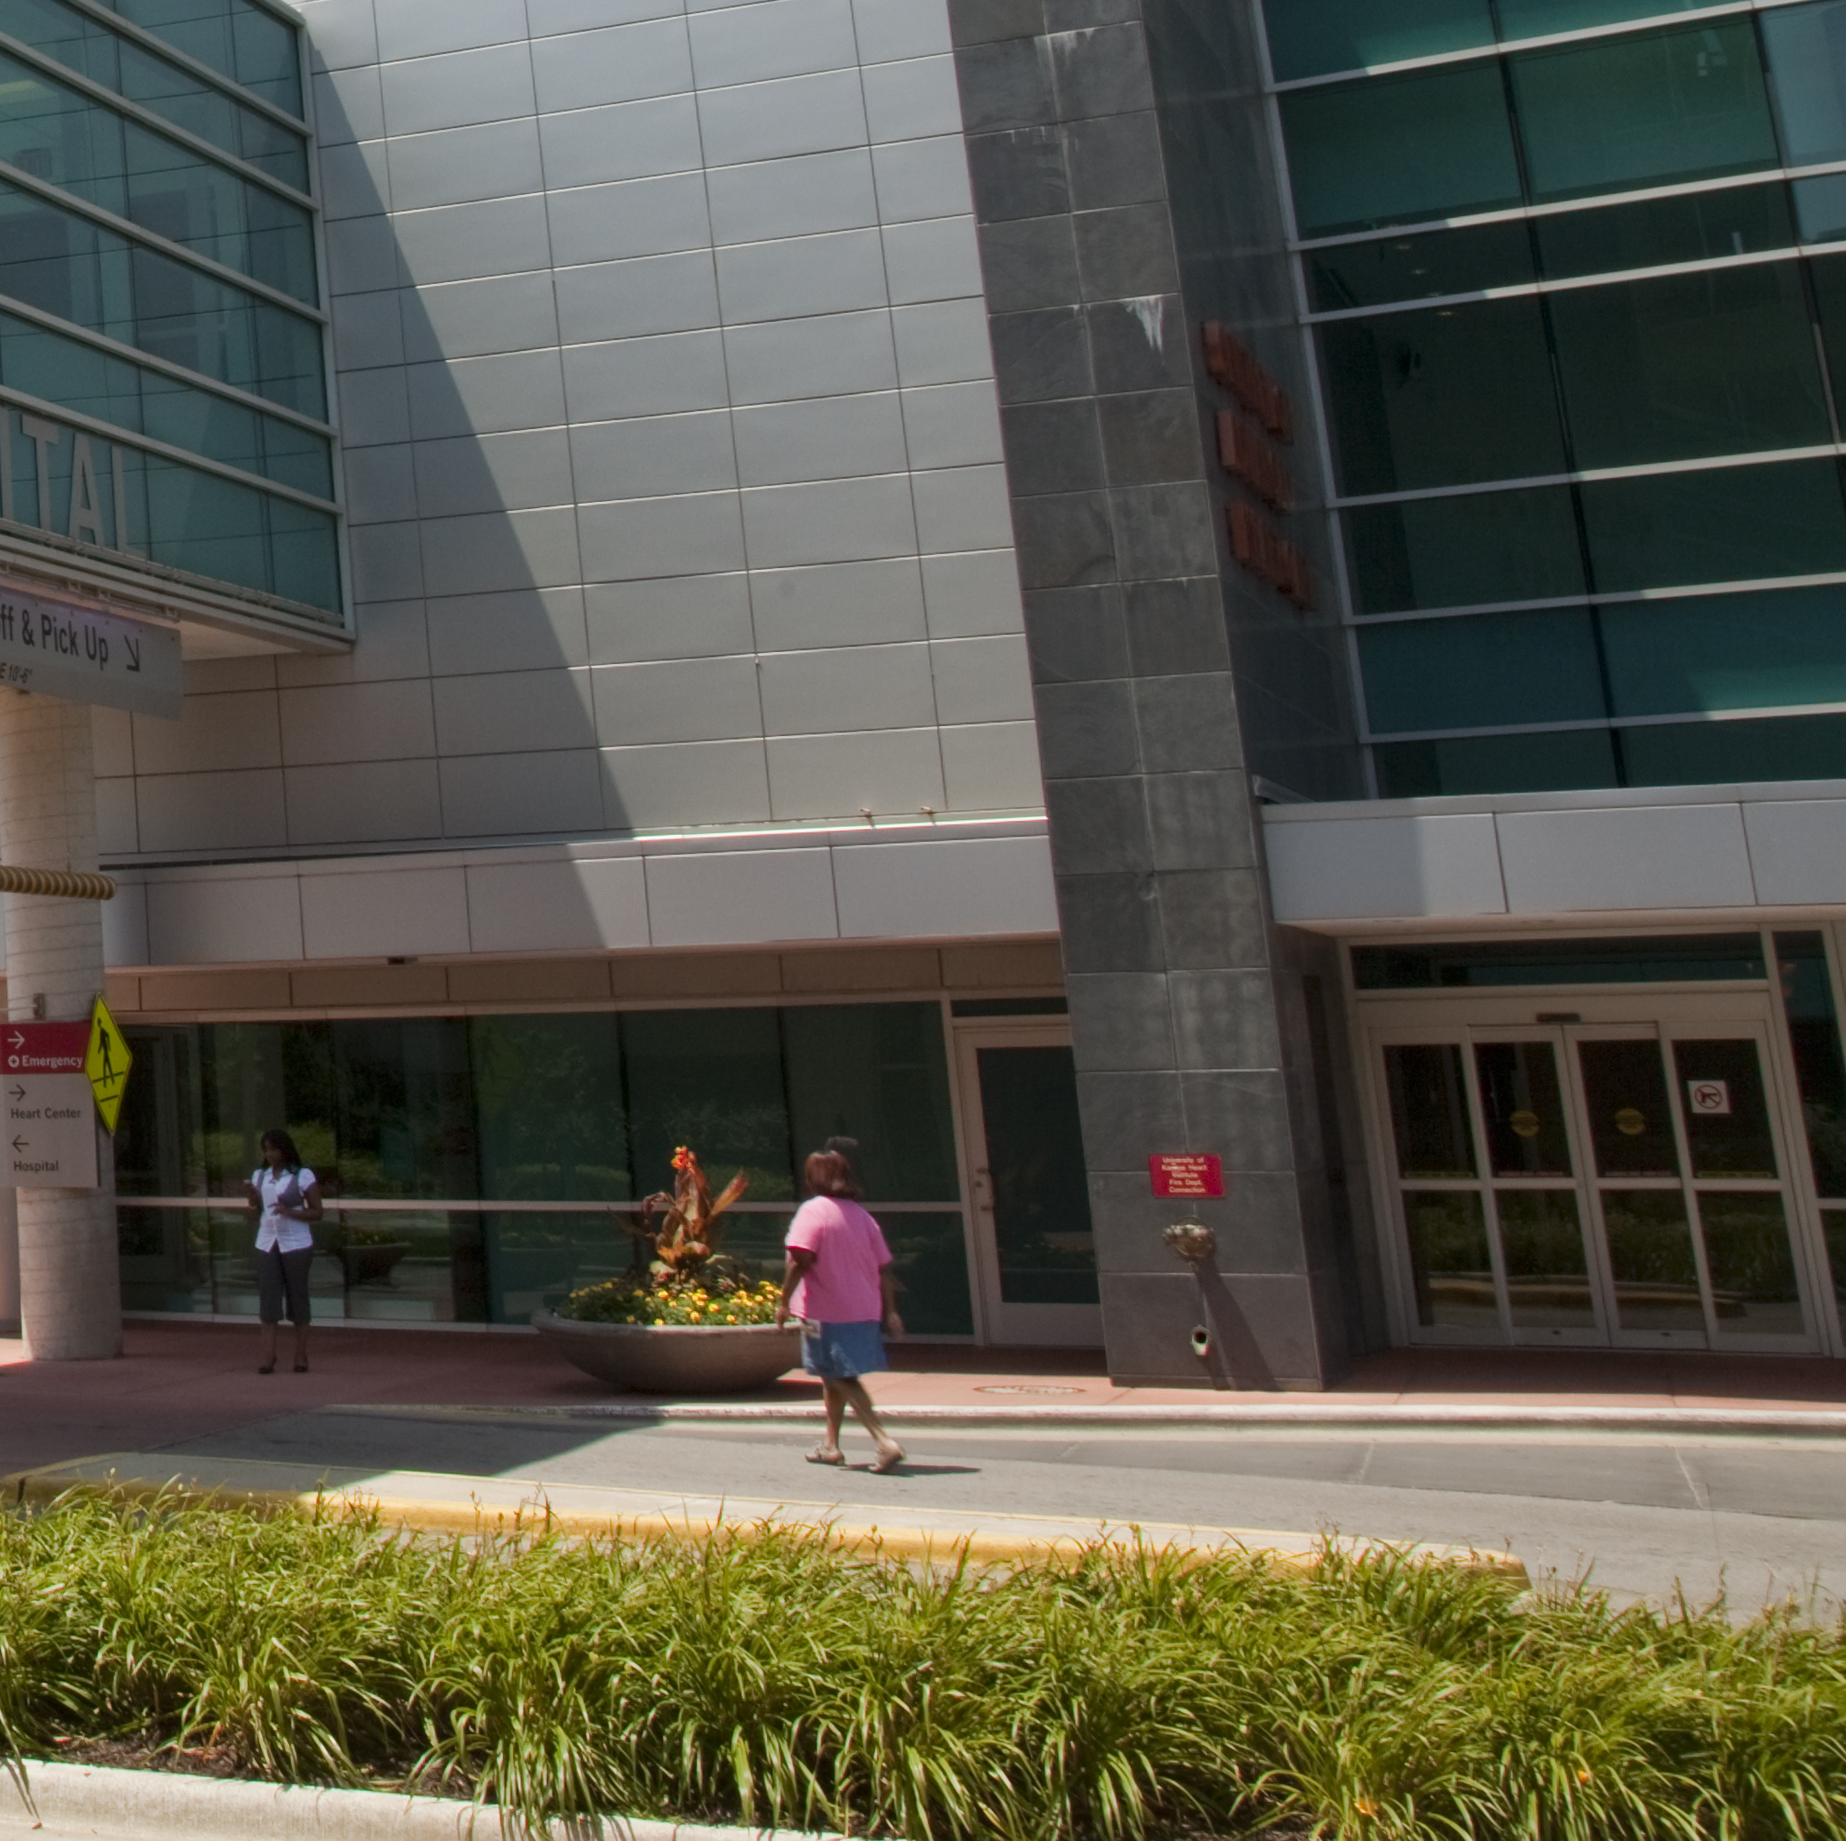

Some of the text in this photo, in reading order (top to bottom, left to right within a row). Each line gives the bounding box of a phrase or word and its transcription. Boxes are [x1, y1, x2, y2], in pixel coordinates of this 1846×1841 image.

[21, 614, 35, 648] &
[41, 614, 79, 656] Pick
[85, 624, 109, 670] Up
[22, 1054, 83, 1069] Emergency
[10, 1107, 82, 1119] Heart Center
[13, 1160, 59, 1174] Hospital
